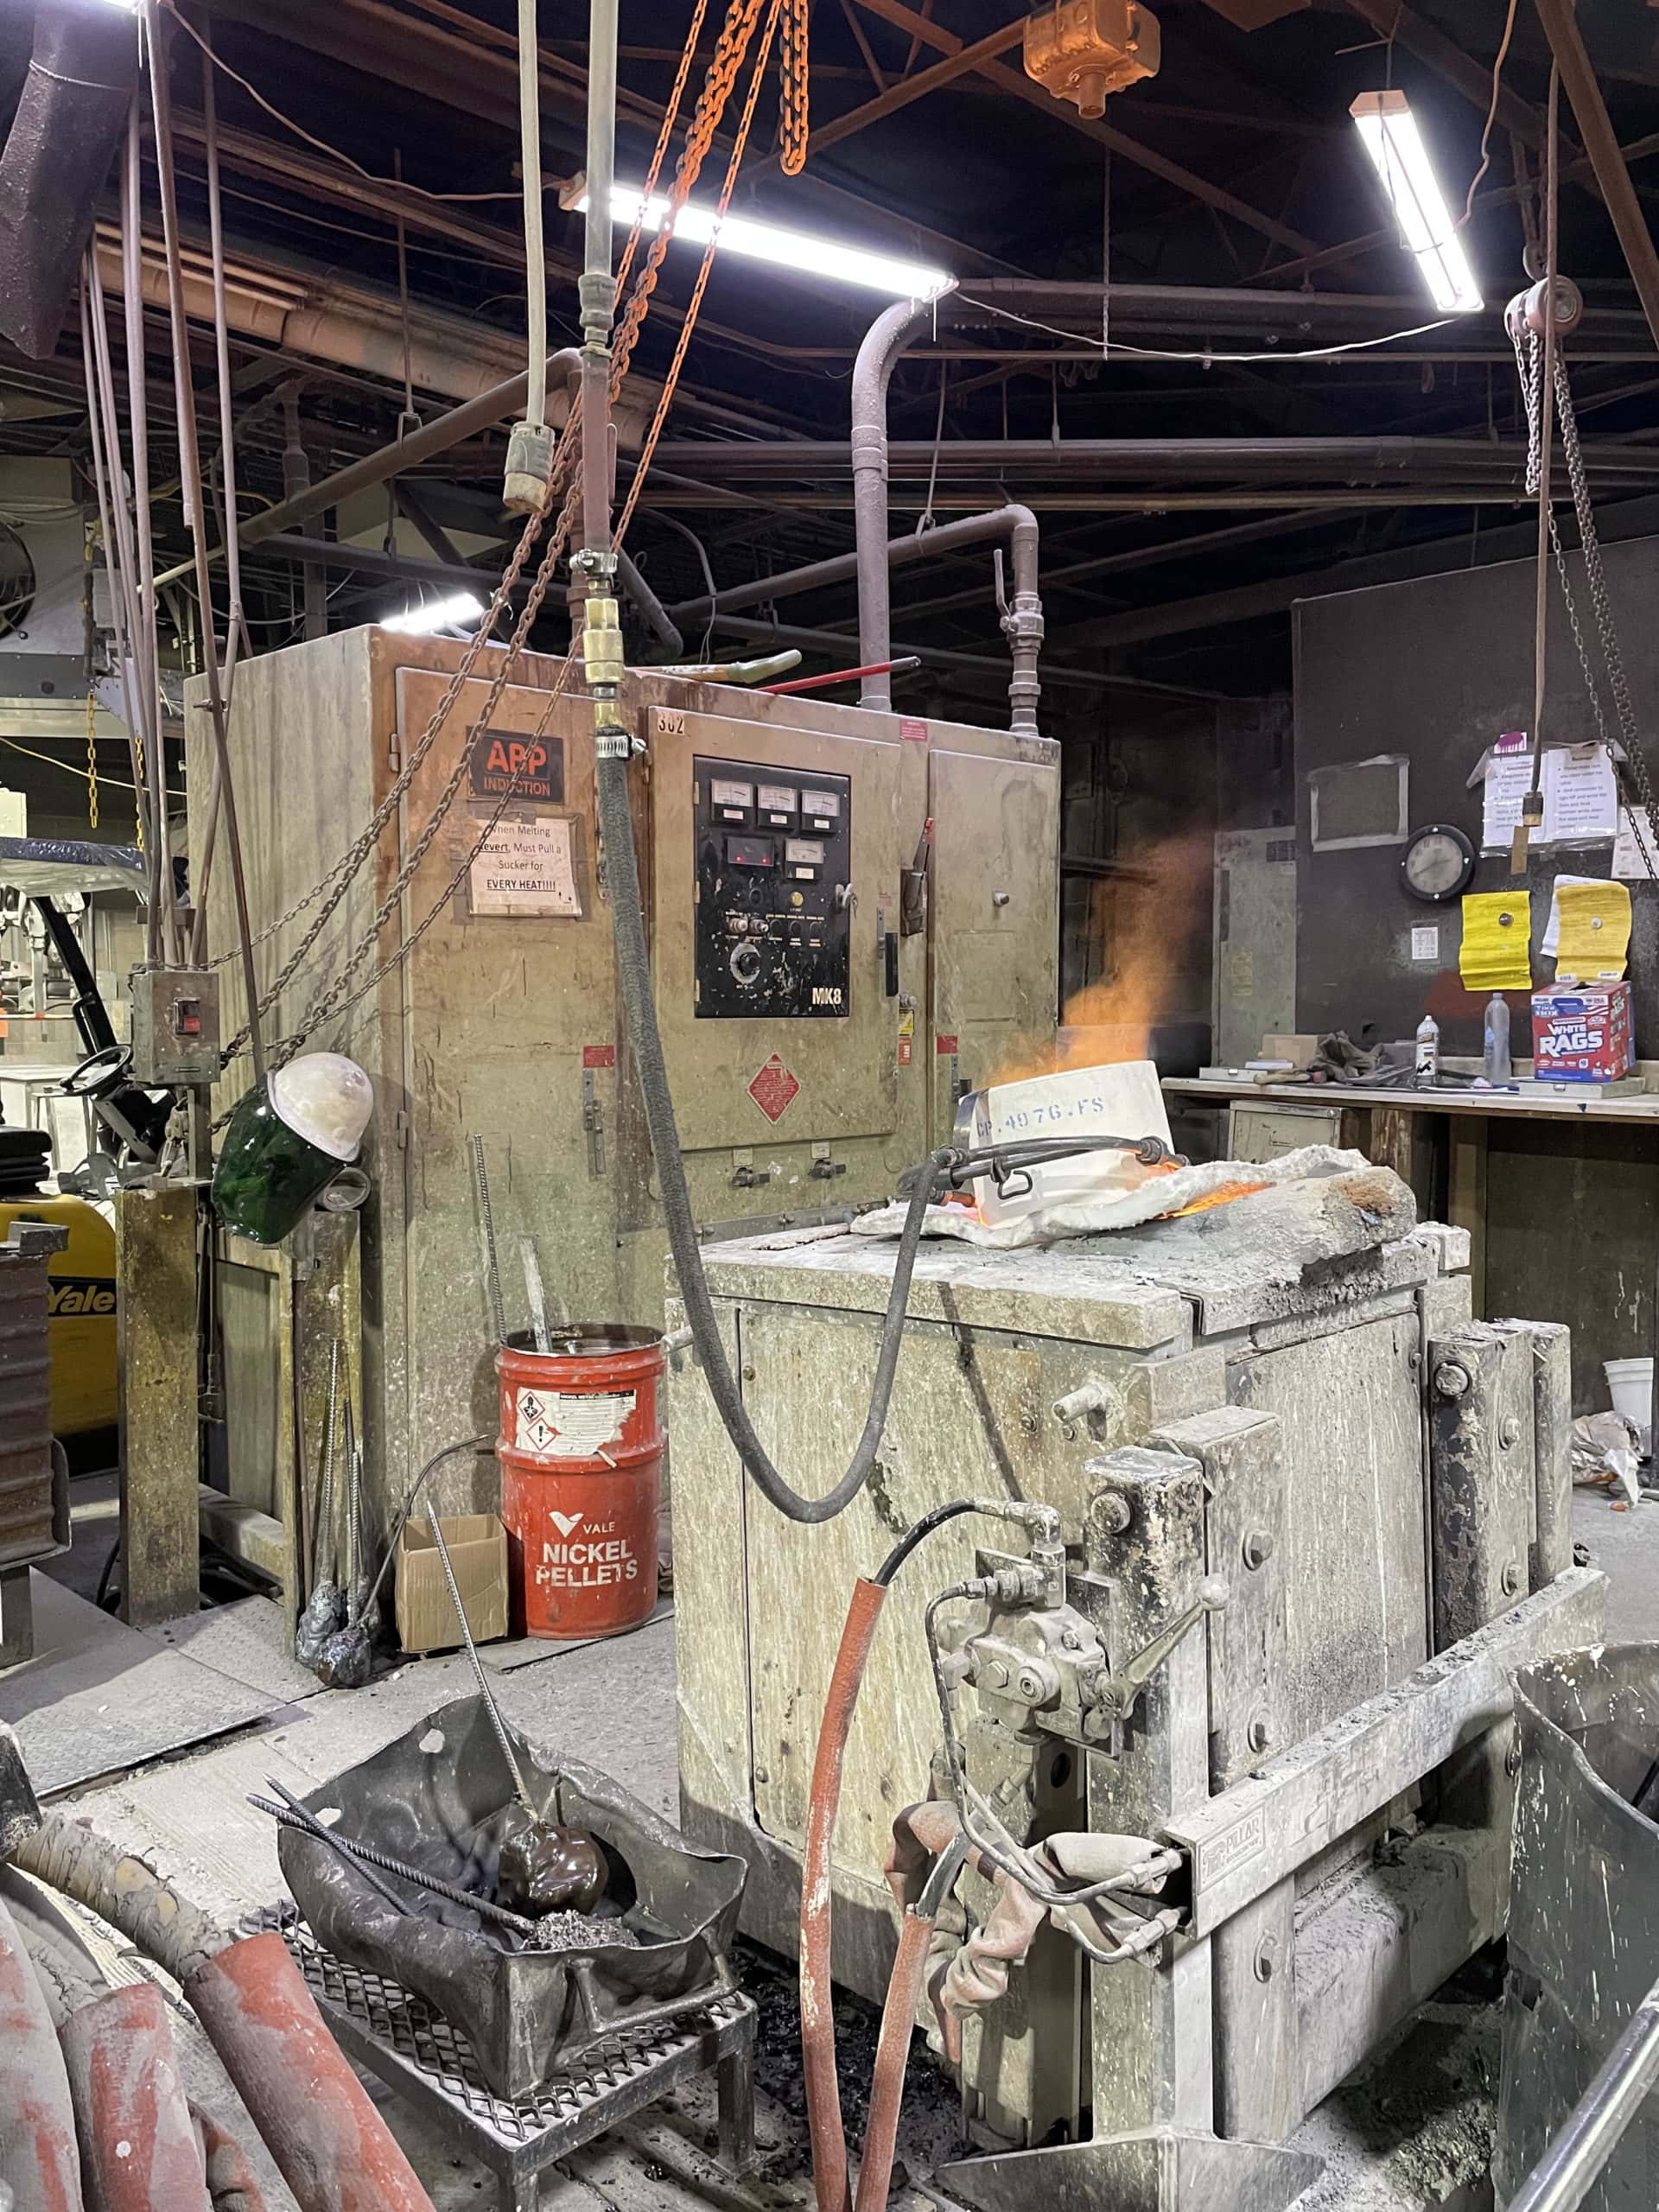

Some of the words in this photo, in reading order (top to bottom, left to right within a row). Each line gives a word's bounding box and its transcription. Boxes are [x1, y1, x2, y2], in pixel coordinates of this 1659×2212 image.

[484, 778, 550, 795] INDCTION
[518, 825, 551, 838] Melting
[513, 843, 536, 854] Must
[538, 843, 555, 854] Pull
[499, 860, 528, 870] Sucker
[531, 861, 543, 871] for
[486, 879, 518, 889] EVERY
[518, 880, 556, 891] HEAT!!!!
[812, 988, 842, 1005] MK8
[1548, 1024, 1587, 1035] WHITE
[1539, 1030, 1604, 1058] RAGS
[48, 1285, 116, 1313] Yale
[582, 1522, 616, 1535] VALE
[543, 1539, 633, 1565] NICKEL
[536, 1559, 638, 1588] PELLETS
